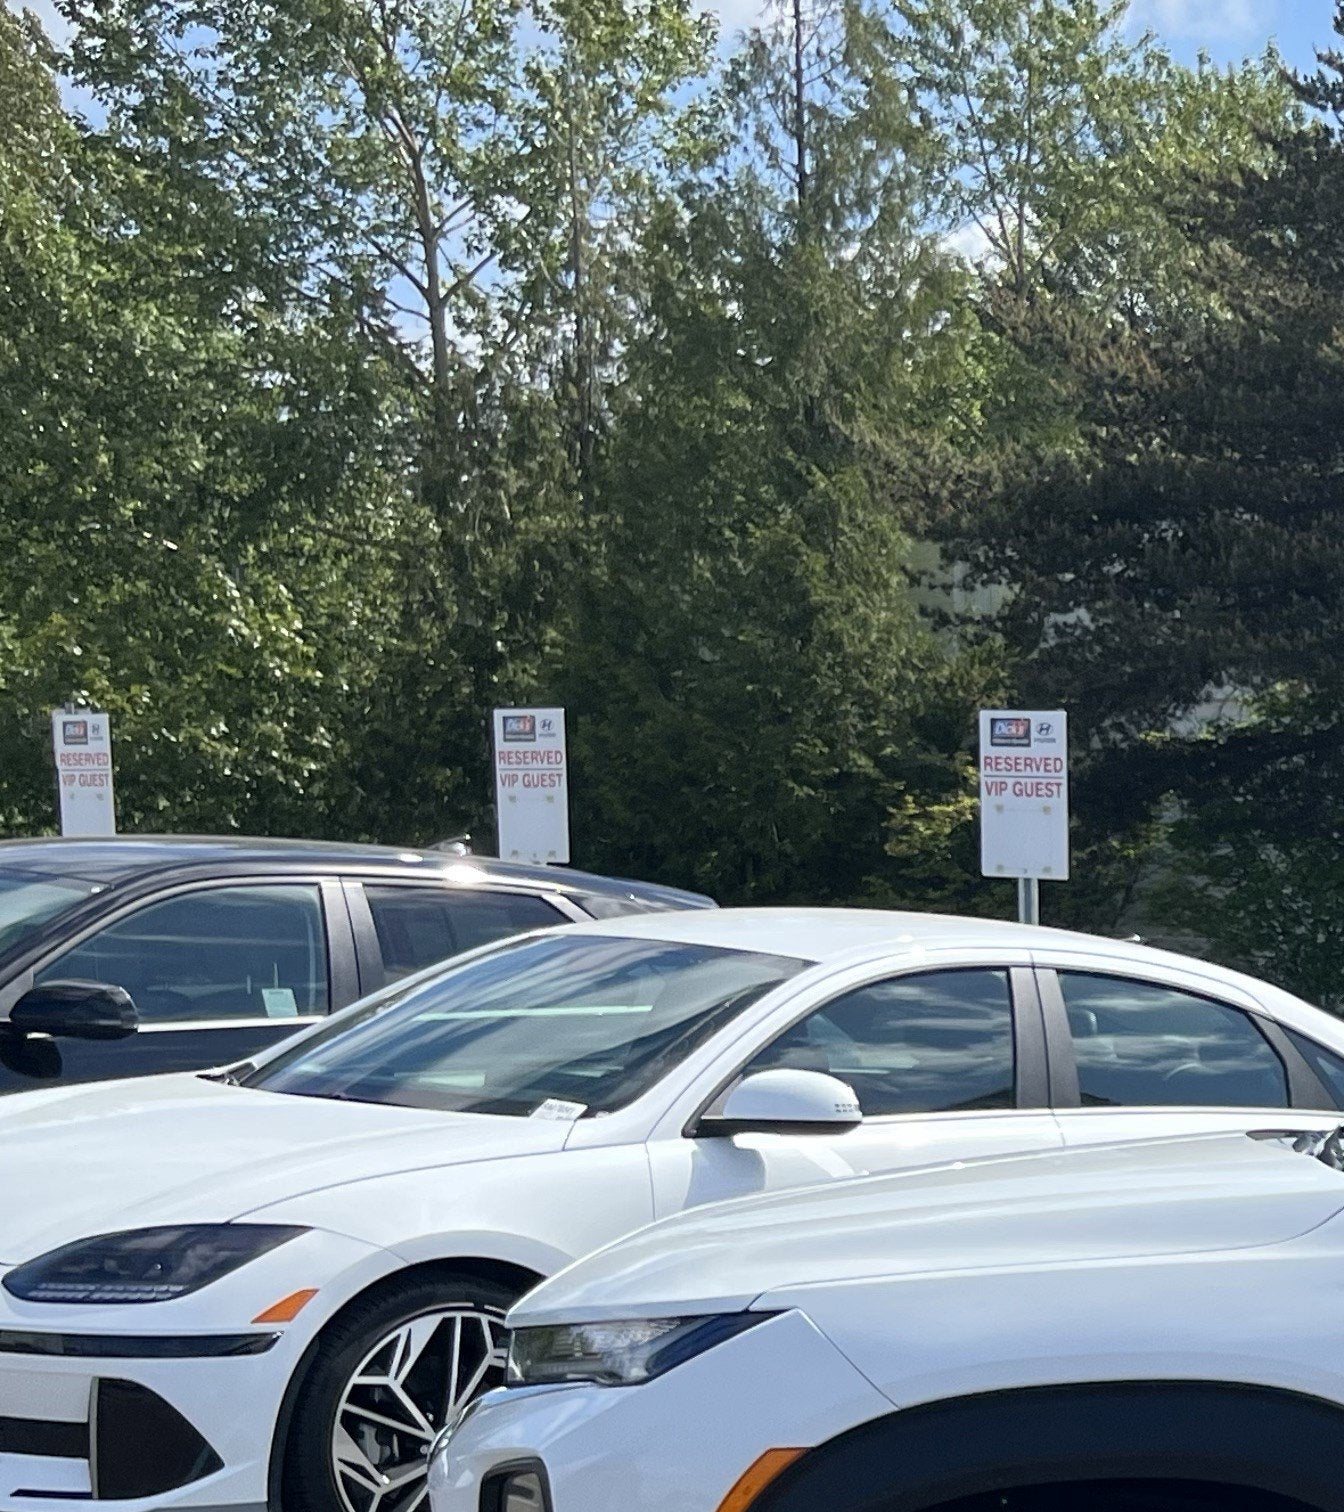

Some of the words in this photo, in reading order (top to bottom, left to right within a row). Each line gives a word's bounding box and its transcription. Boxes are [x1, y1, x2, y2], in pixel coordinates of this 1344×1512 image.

[60, 752, 109, 766] RESERVED
[498, 750, 563, 766] RESERVED
[983, 755, 1063, 774] RESERVED
[500, 773, 519, 788] VIP
[522, 773, 563, 788] GUEST
[984, 780, 1008, 797] VIP
[1012, 780, 1063, 799] GUEST
